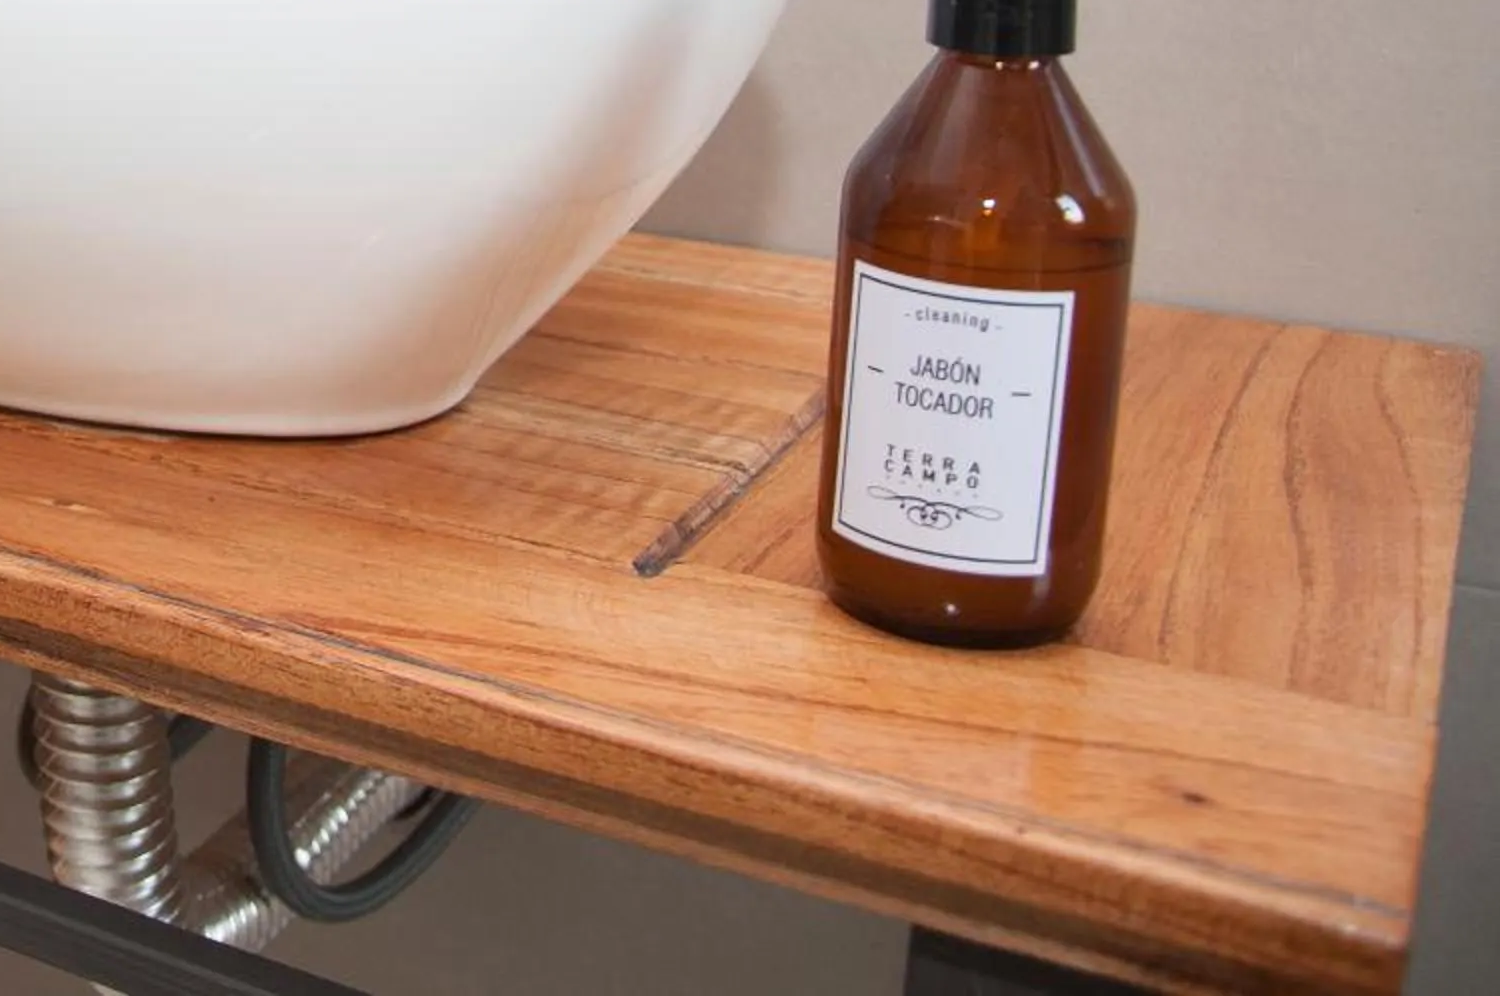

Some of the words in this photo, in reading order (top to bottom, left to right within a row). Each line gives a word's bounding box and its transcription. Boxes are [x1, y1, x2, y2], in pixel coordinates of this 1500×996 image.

[915, 306, 990, 333] cleaning
[909, 354, 981, 386] JABÓN
[894, 381, 994, 419] TOCADOR
[884, 459, 979, 489] CAMPO
[886, 443, 981, 475] TERRA
